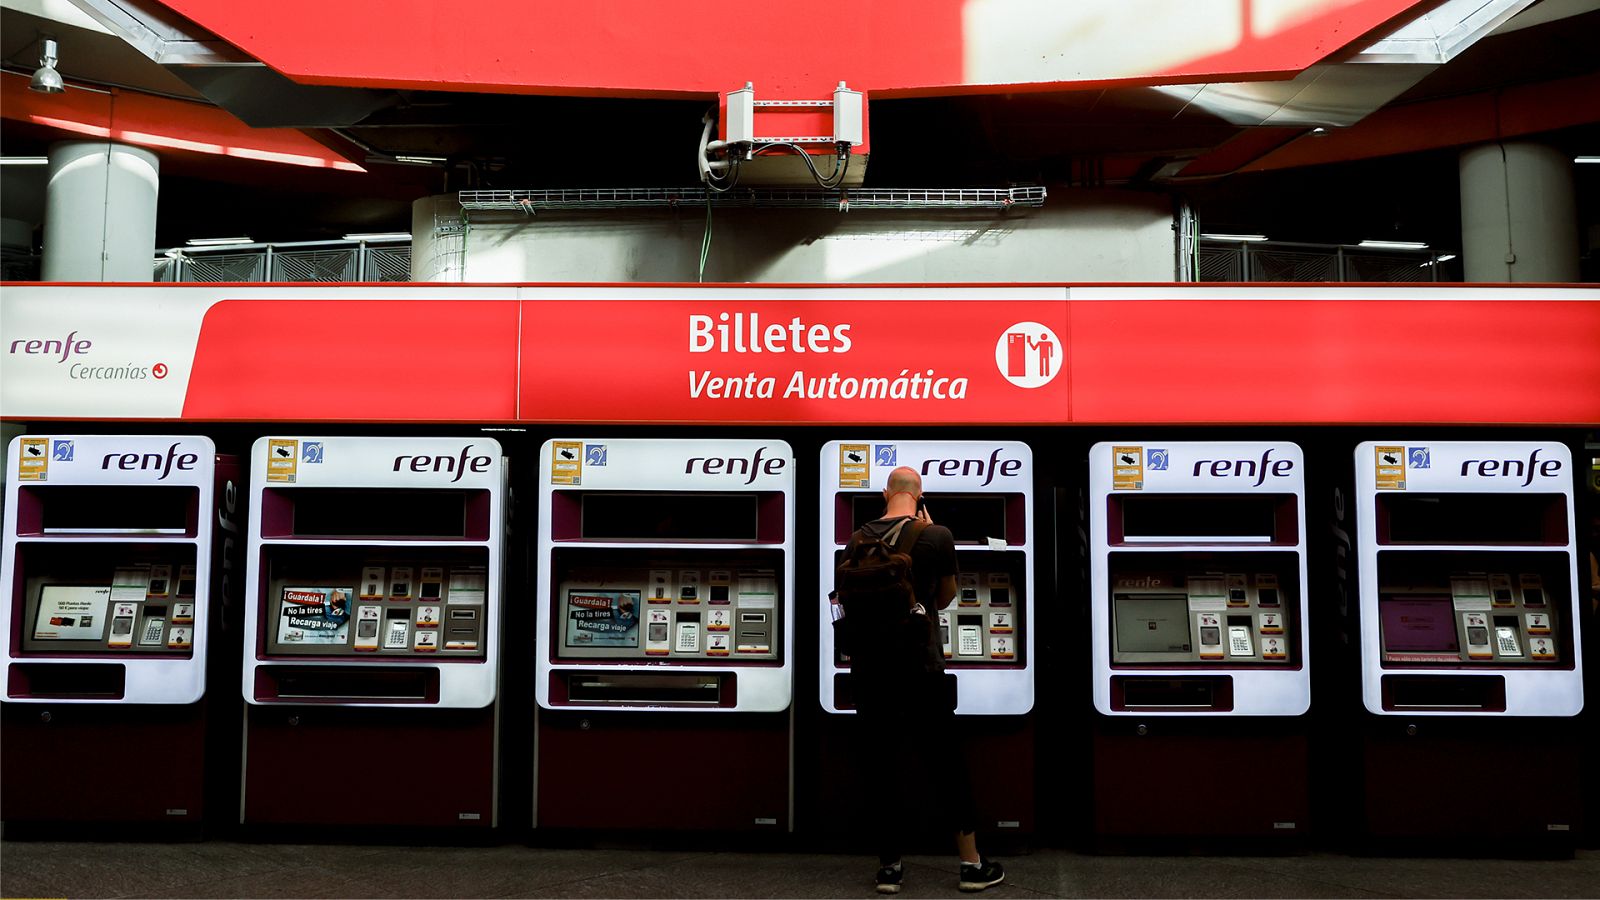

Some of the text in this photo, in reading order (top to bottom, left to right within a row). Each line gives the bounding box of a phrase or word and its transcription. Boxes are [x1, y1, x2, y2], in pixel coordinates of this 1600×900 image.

[9, 330, 92, 364] renfe
[689, 312, 852, 353] Billetes
[69, 362, 148, 380] Cercanías
[688, 369, 969, 400] Venta Automática
[101, 442, 199, 481] renfe
[392, 444, 492, 483] renfe
[685, 446, 786, 485] renfe
[920, 447, 1022, 487] renfe
[1192, 448, 1294, 487] renfe
[1460, 448, 1562, 487] renfe
[290, 617, 338, 630] Recarga viaje
[307, 606, 323, 614] tires
[578, 620, 627, 632] Recarga viaje
[586, 610, 593, 618] la
